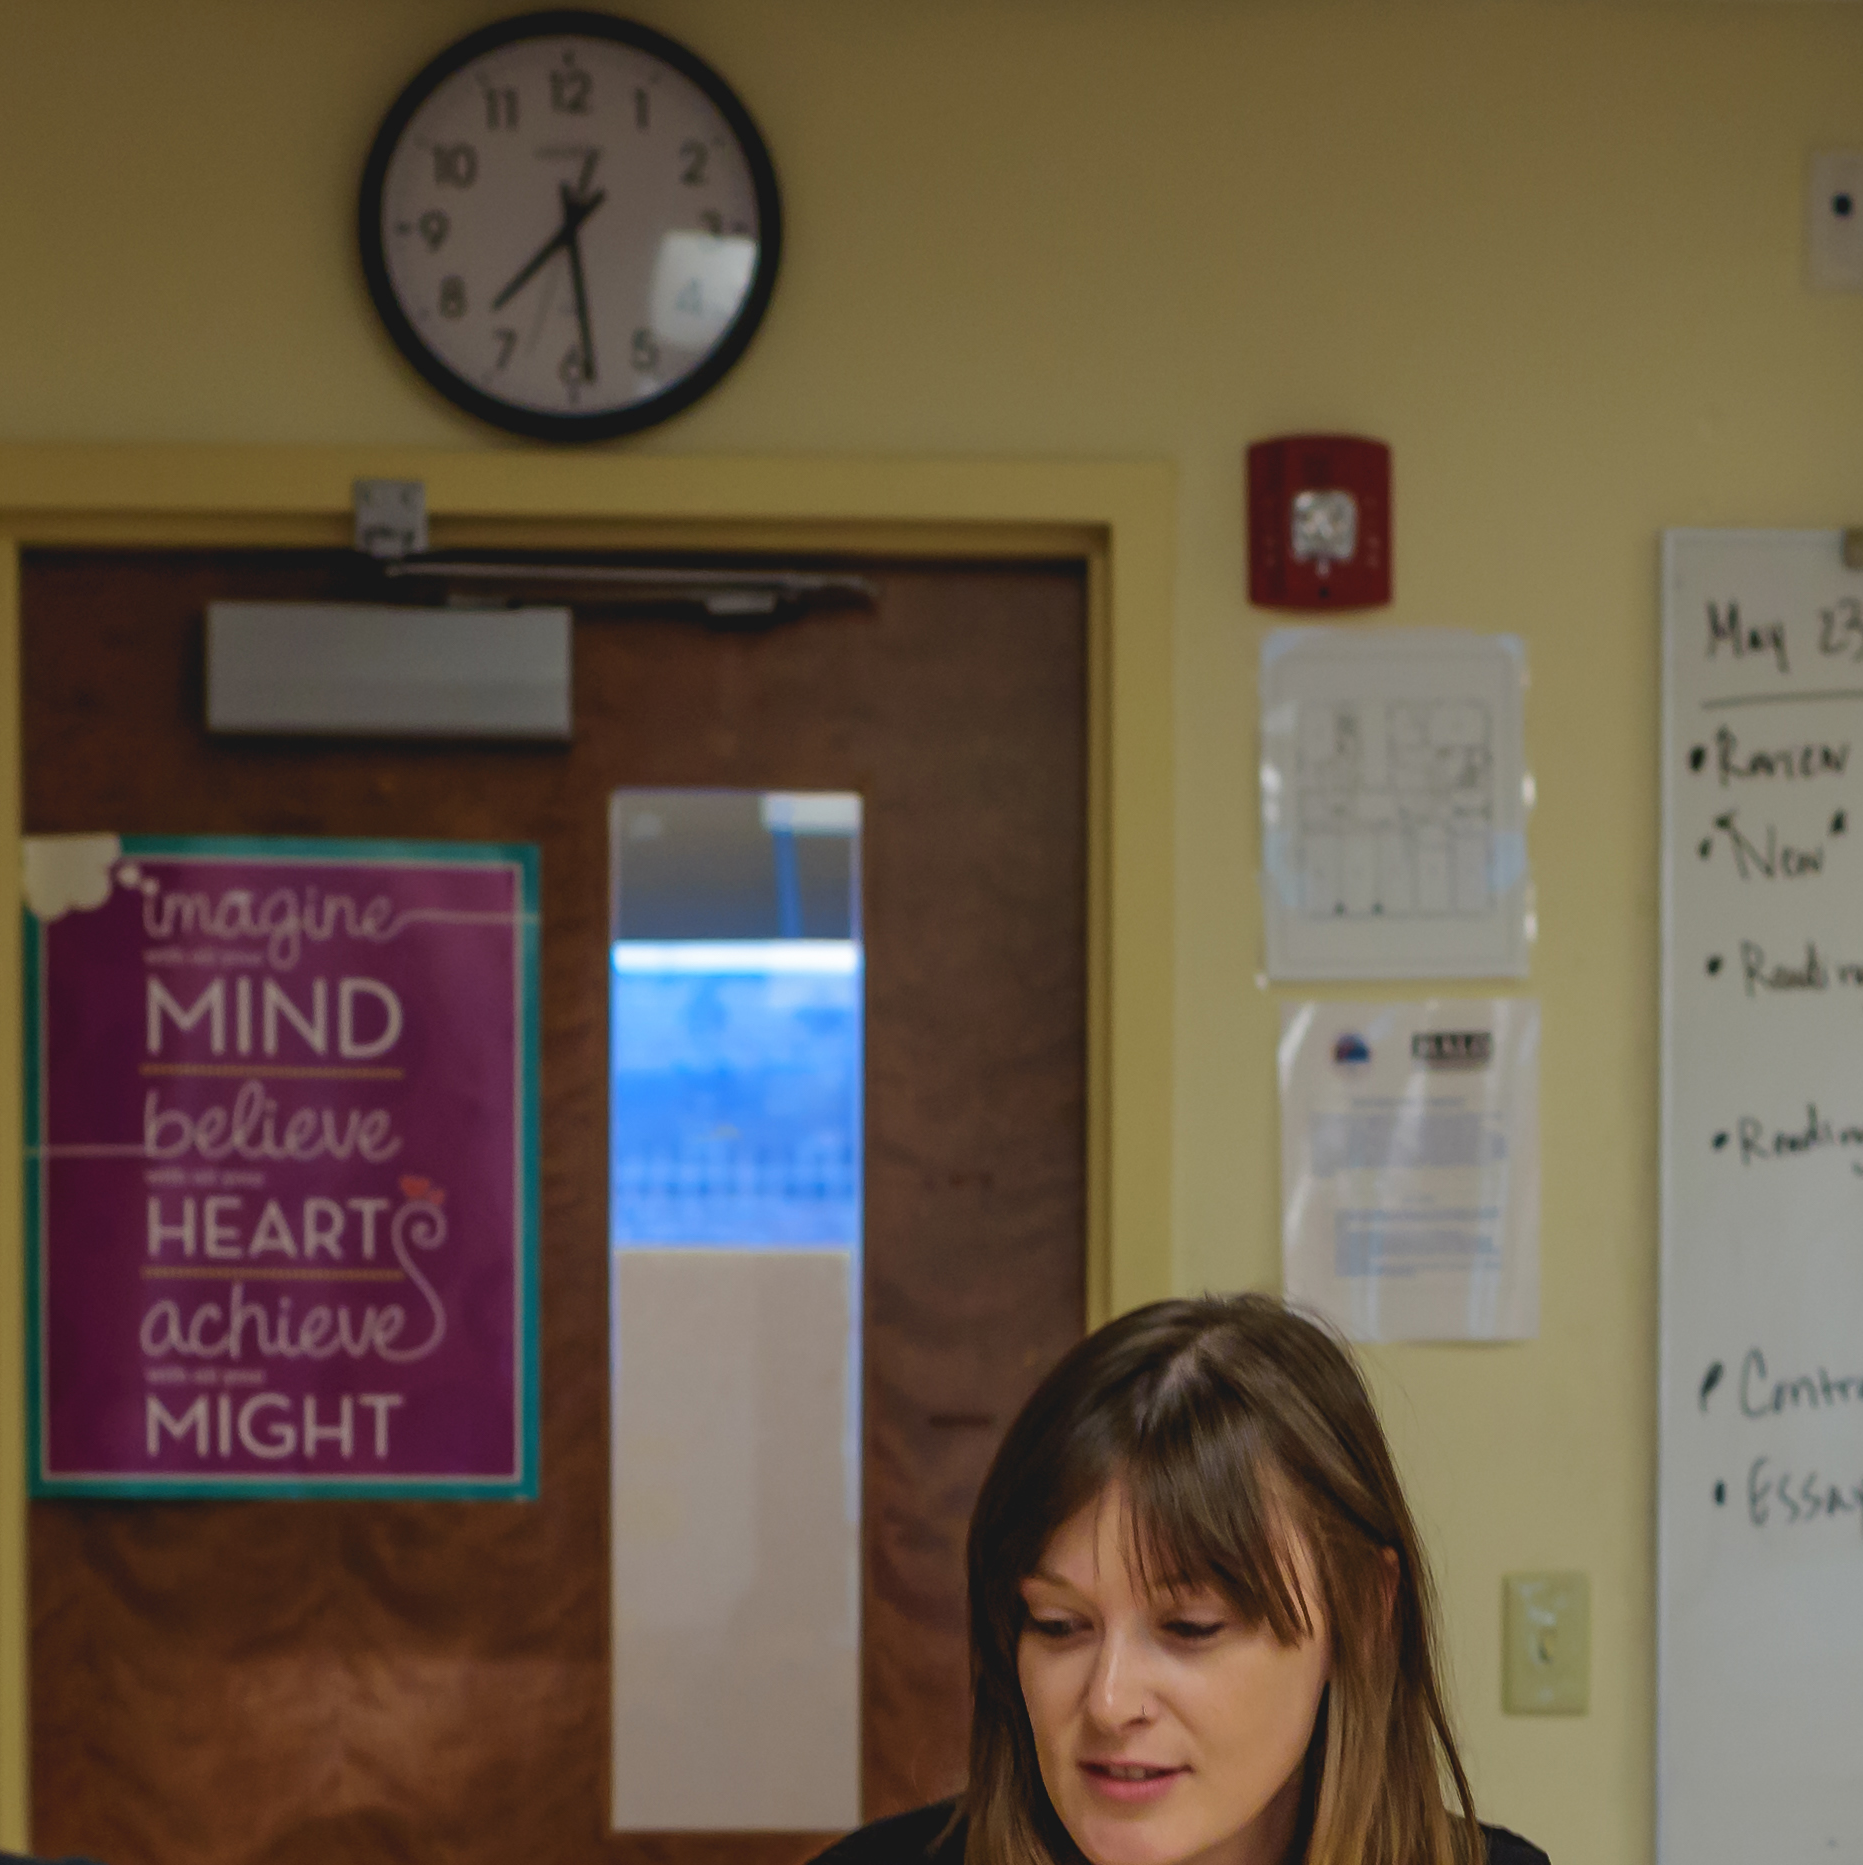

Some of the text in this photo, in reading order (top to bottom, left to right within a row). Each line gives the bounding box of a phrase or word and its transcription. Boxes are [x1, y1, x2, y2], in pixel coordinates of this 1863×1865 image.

[485, 88, 520, 130] 11
[548, 70, 593, 115] 12
[632, 88, 652, 129] 1
[432, 144, 477, 188] 10
[679, 145, 708, 186] 2
[418, 210, 449, 252] 9
[700, 211, 726, 249] 3
[440, 276, 468, 318] 8
[675, 277, 704, 315] 4
[494, 330, 520, 370] 7
[558, 348, 590, 385] 6
[631, 328, 659, 370] 5
[1705, 597, 1790, 674] May
[142, 876, 406, 971] imagine
[146, 975, 404, 1059] MIND
[143, 1080, 402, 1164] believe
[147, 1196, 391, 1260] HEART
[141, 1283, 409, 1361] achieve
[144, 1395, 405, 1460] MIGHT
